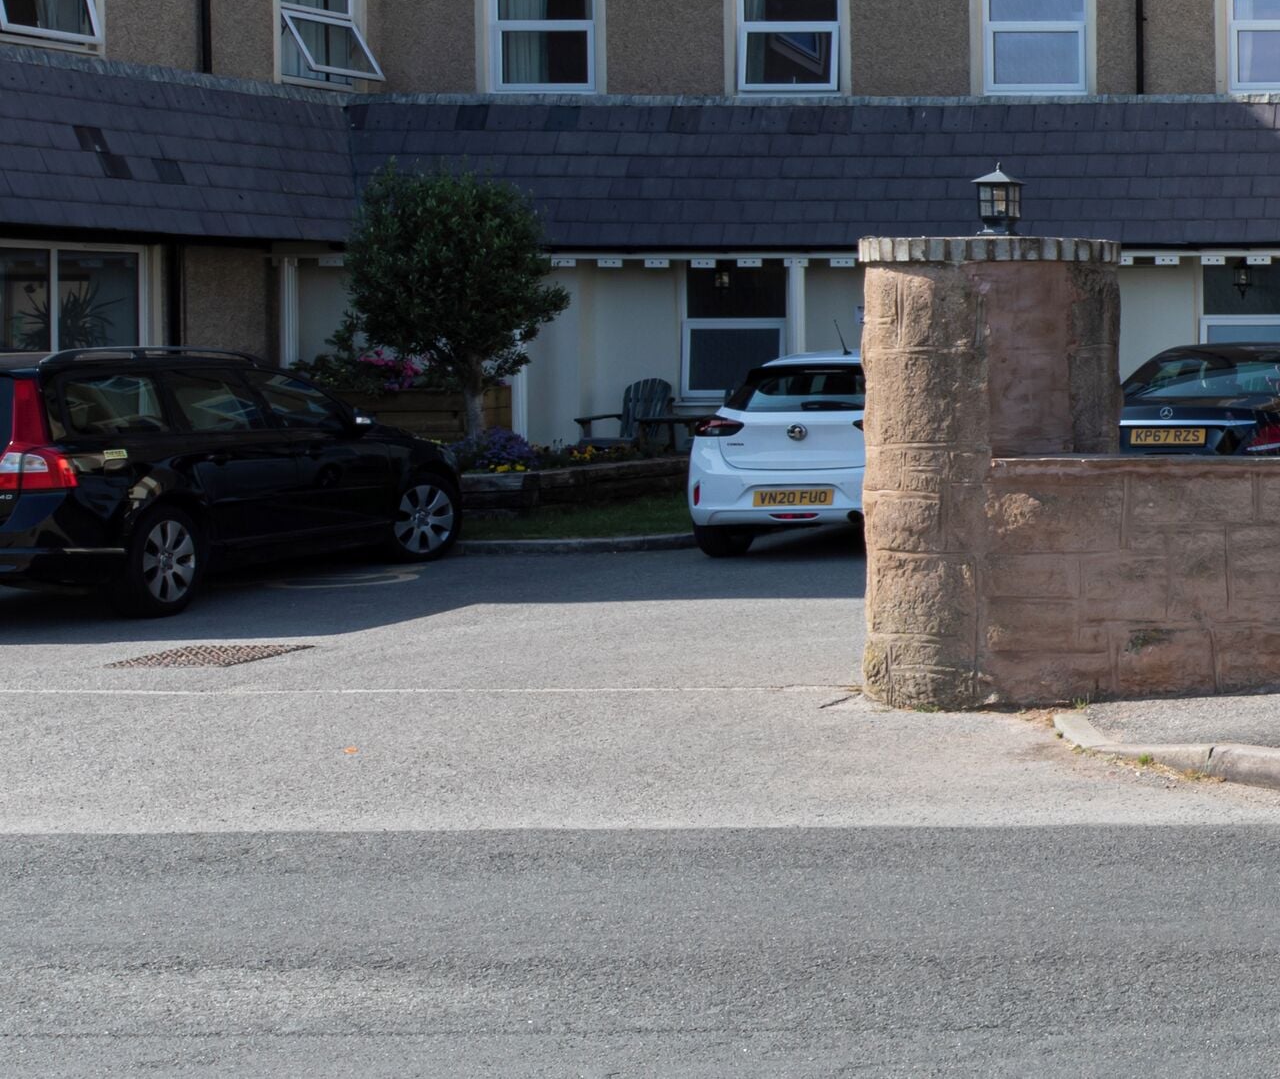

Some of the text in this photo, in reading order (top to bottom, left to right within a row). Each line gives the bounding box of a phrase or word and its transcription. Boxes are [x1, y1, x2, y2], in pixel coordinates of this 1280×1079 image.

[1135, 429, 1200, 442] KP67 RZS
[759, 490, 828, 505] VN20 FUO
